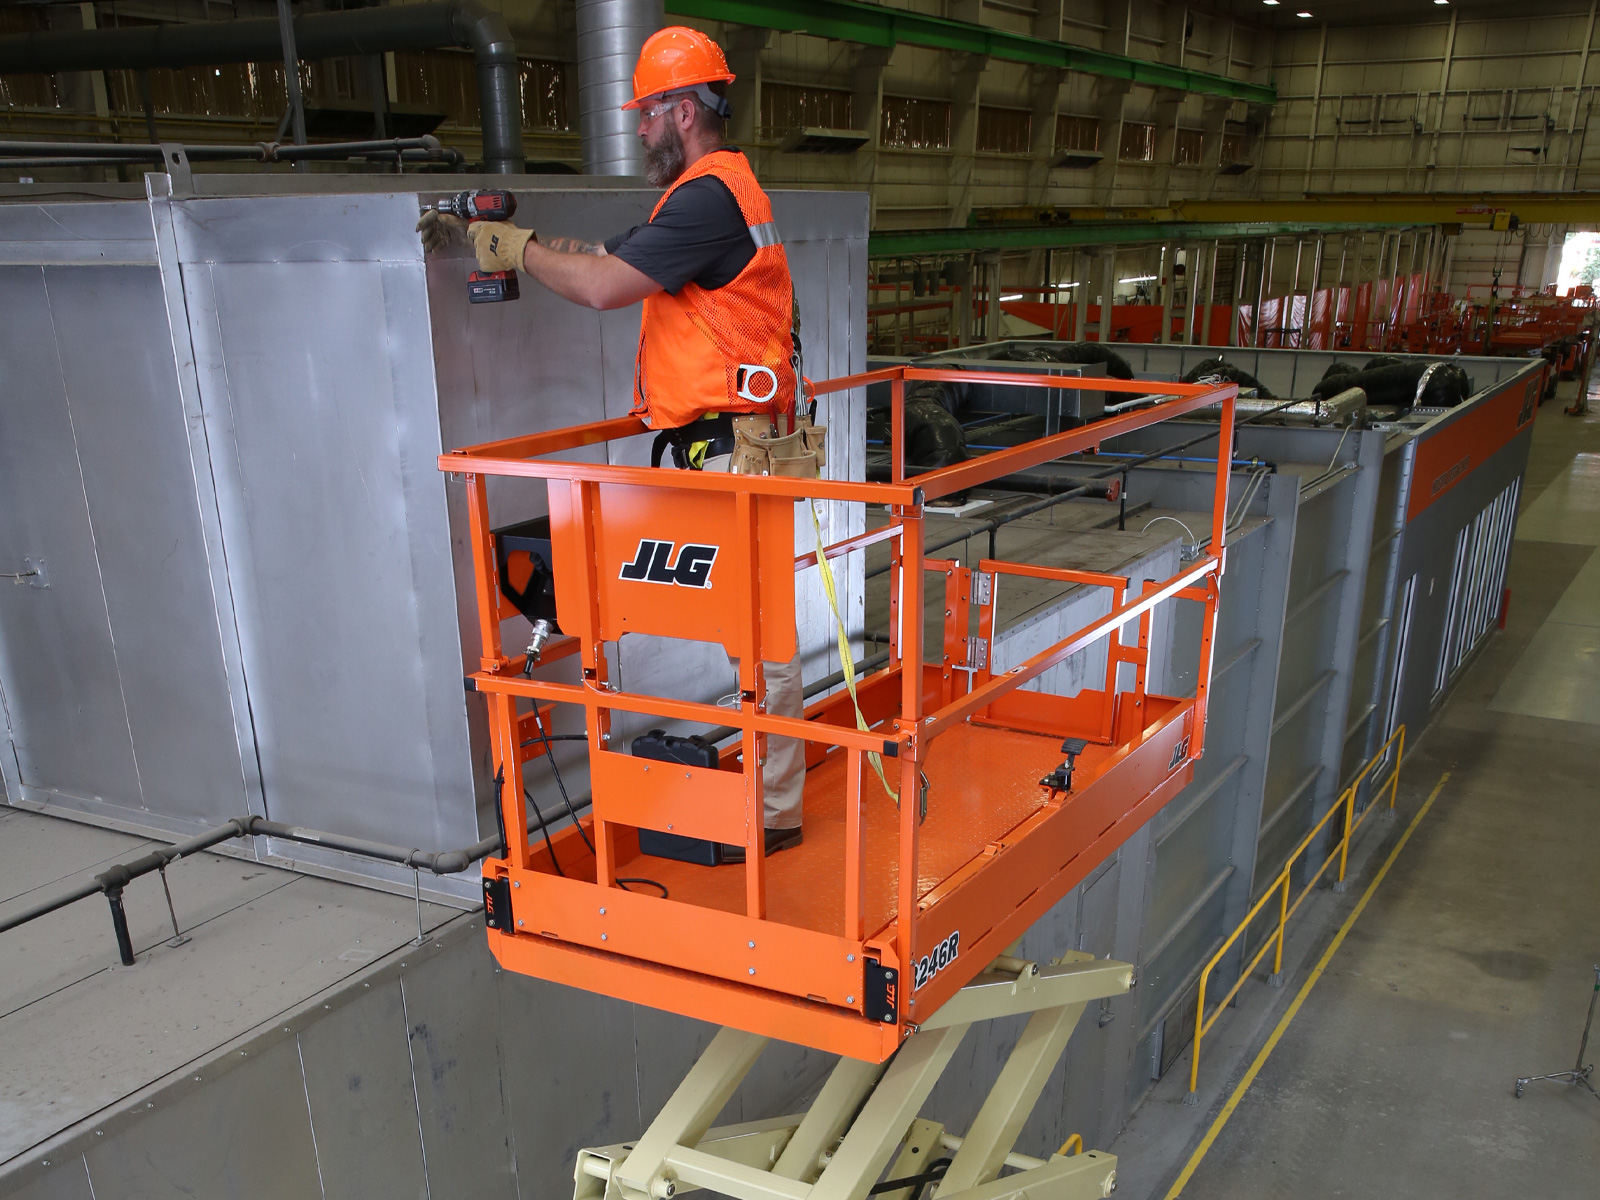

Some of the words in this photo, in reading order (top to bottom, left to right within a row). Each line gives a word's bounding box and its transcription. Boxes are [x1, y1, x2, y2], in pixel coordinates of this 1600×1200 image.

[489, 234, 500, 257] JLG
[1515, 374, 1541, 431] JLG
[618, 538, 720, 589] JLG
[1167, 734, 1191, 772] JLG
[485, 891, 495, 915] JLG
[886, 983, 896, 1009] JLG
